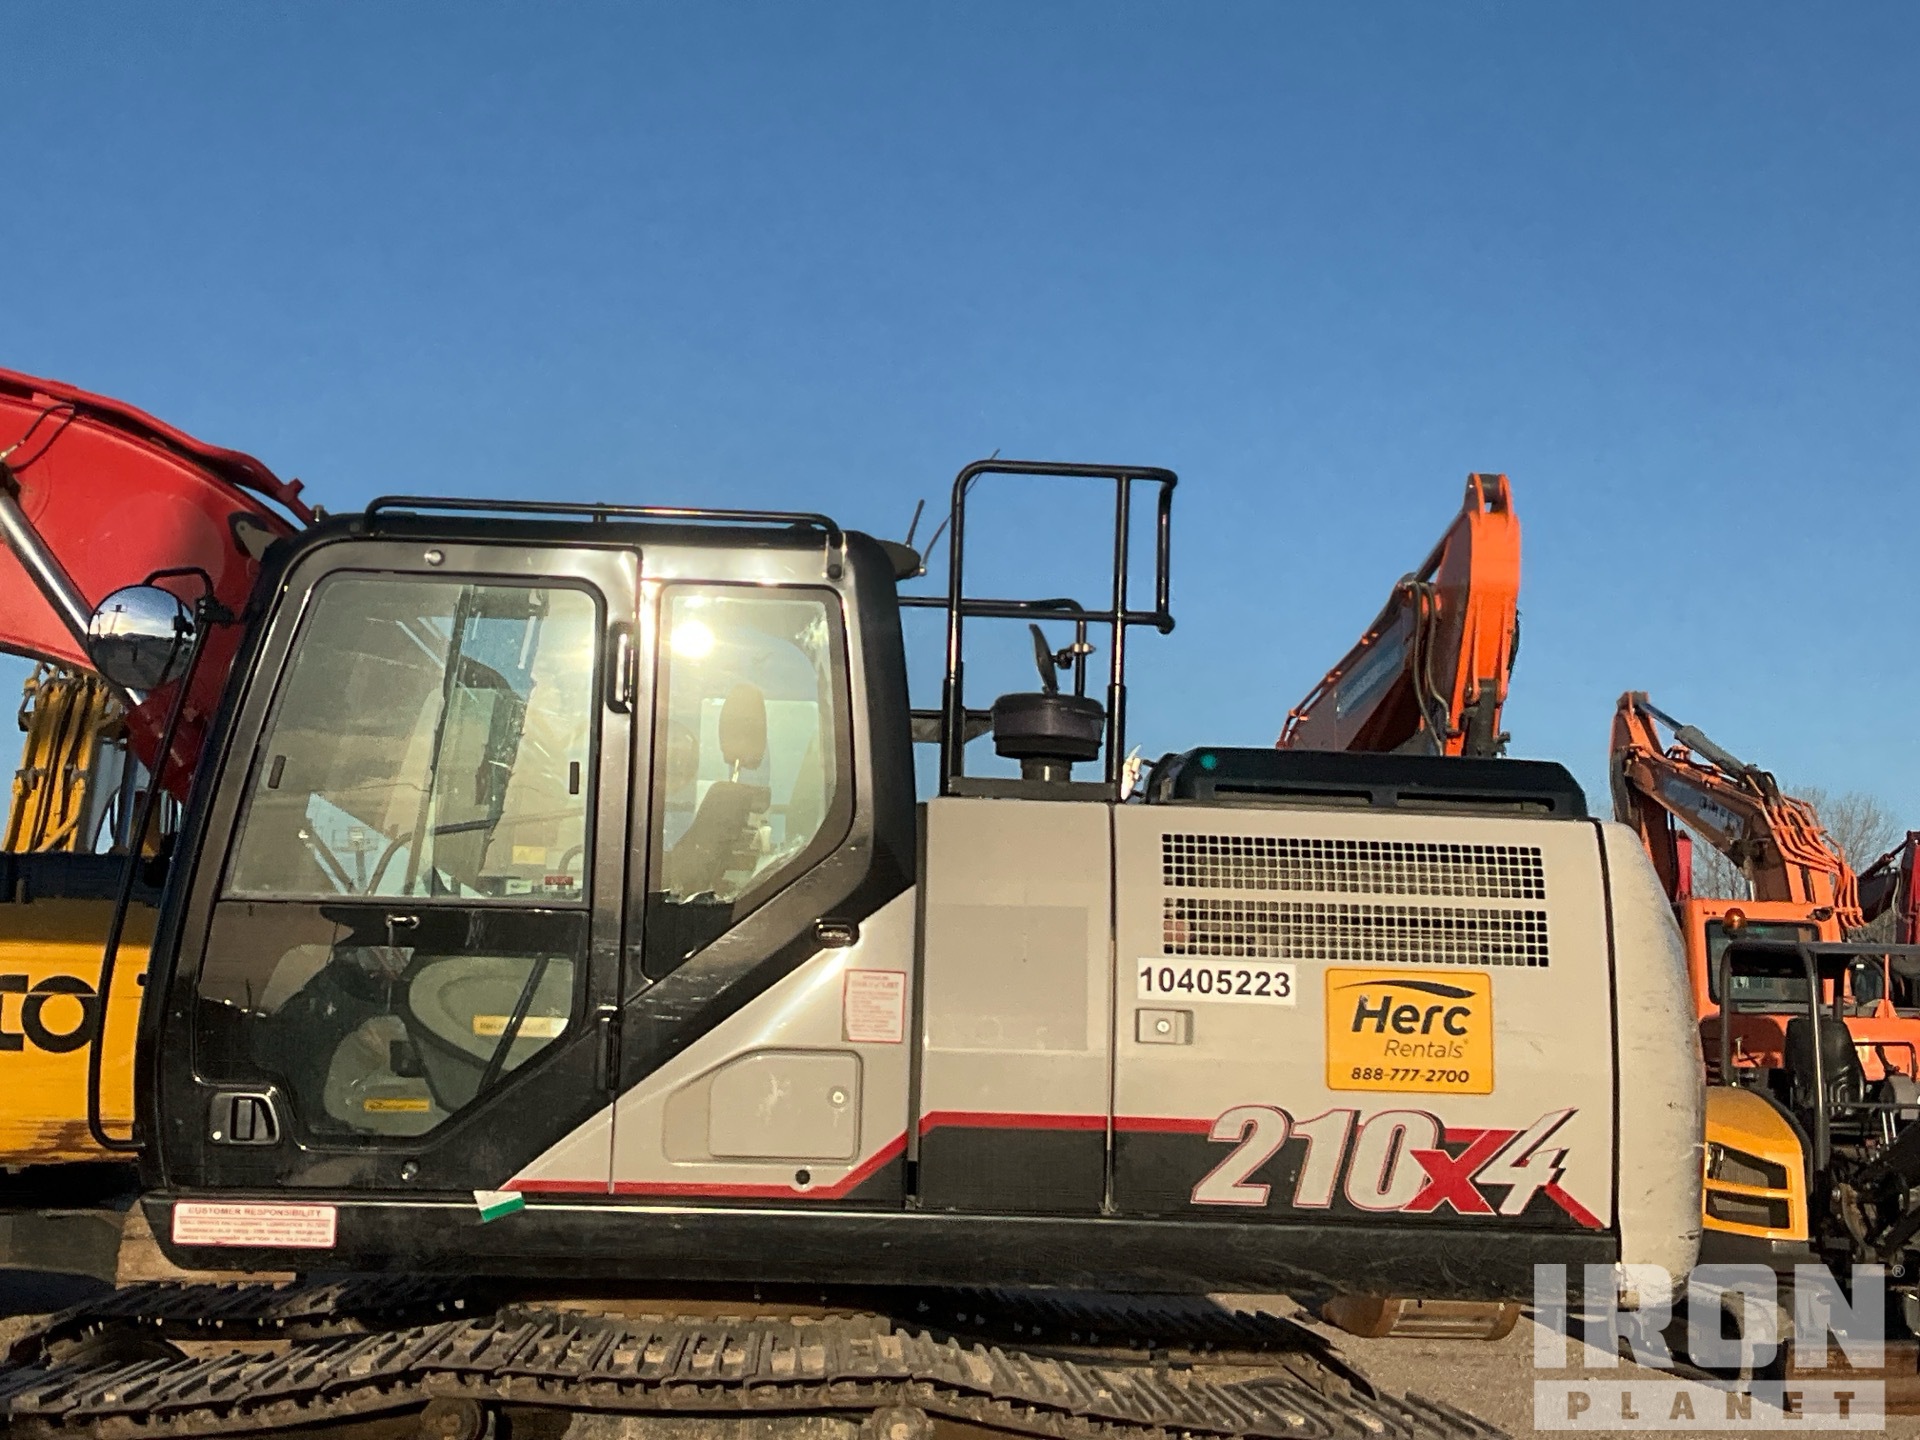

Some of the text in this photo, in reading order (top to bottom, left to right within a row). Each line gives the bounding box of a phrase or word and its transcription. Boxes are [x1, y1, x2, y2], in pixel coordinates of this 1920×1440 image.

[1139, 965, 1291, 998] 10405223
[1351, 995, 1472, 1036] Herc
[1384, 1039, 1465, 1059] Rentals
[1351, 1067, 1470, 1084] 888-777-2700
[188, 1206, 321, 1217] CUSTOMER RESPONSIBILITY
